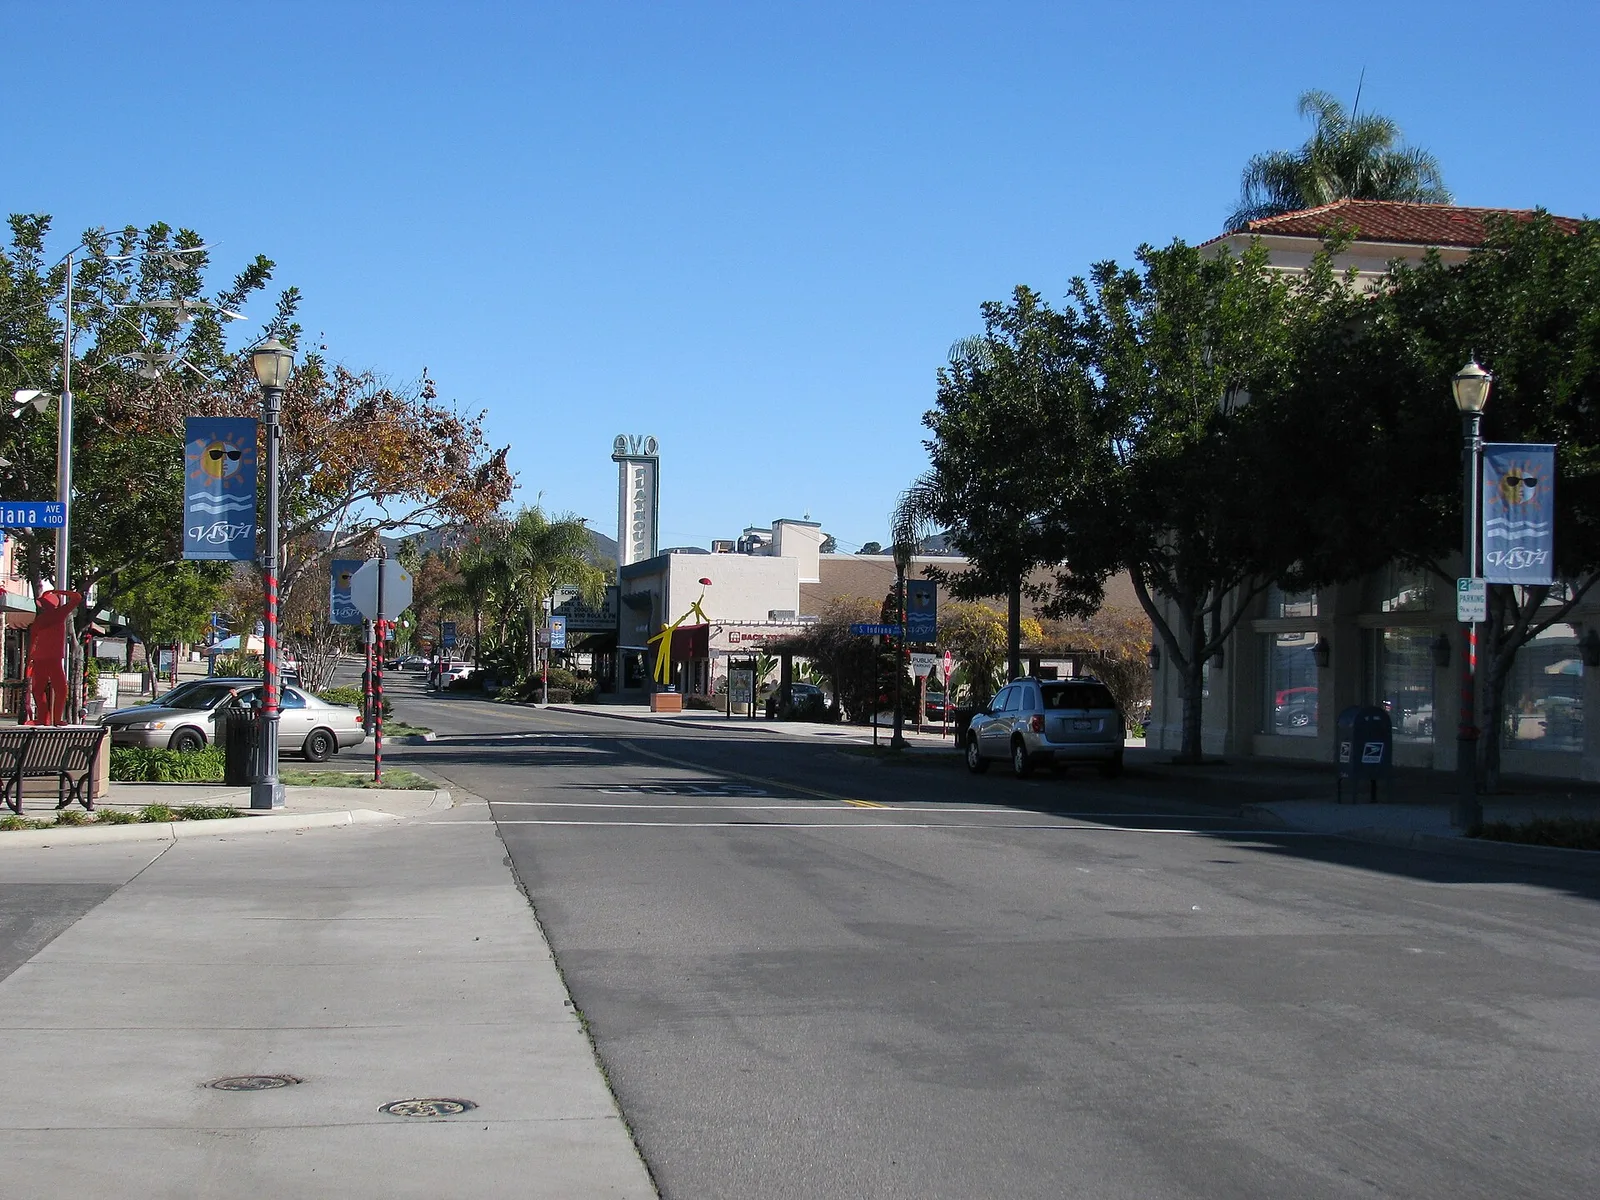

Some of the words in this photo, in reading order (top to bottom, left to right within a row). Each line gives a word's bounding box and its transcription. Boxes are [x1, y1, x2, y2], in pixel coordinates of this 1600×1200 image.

[613, 434, 659, 455] AVO
[45, 505, 61, 513] AVE
[49, 515, 63, 524] 100
[188, 521, 253, 544] VISTA
[1486, 547, 1549, 570] VISTA
[1460, 580, 1468, 590] 2
[1460, 595, 1485, 603] PARKING
[867, 625, 892, 634] Indiana
[741, 633, 764, 641] BACK
[913, 656, 933, 664] PUBLIC
